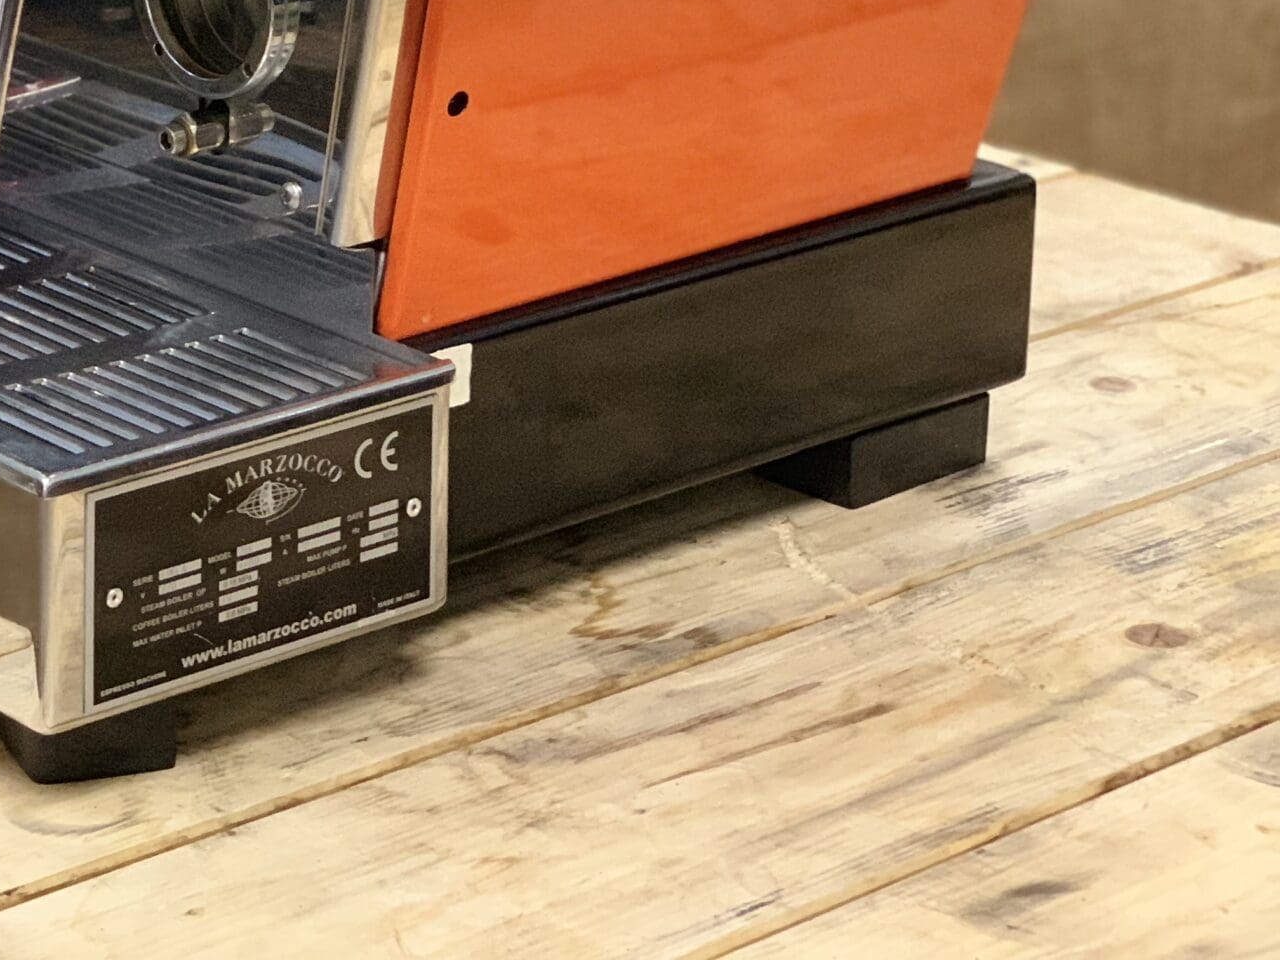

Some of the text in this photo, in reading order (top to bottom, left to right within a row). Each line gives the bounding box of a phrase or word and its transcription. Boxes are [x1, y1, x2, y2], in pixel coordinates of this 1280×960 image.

[191, 452, 344, 525] LA MARZOCCO
[346, 510, 365, 522] DATE
[208, 552, 232, 564] MODEL
[140, 600, 166, 614] STEAM
[167, 592, 193, 606] BOILER
[132, 617, 160, 632] COFFEE
[162, 609, 189, 623] BOILER
[132, 637, 148, 648] MAX
[149, 627, 175, 643] WATER
[175, 623, 196, 636] INLET
[181, 602, 357, 668] www.lamarzocco.com
